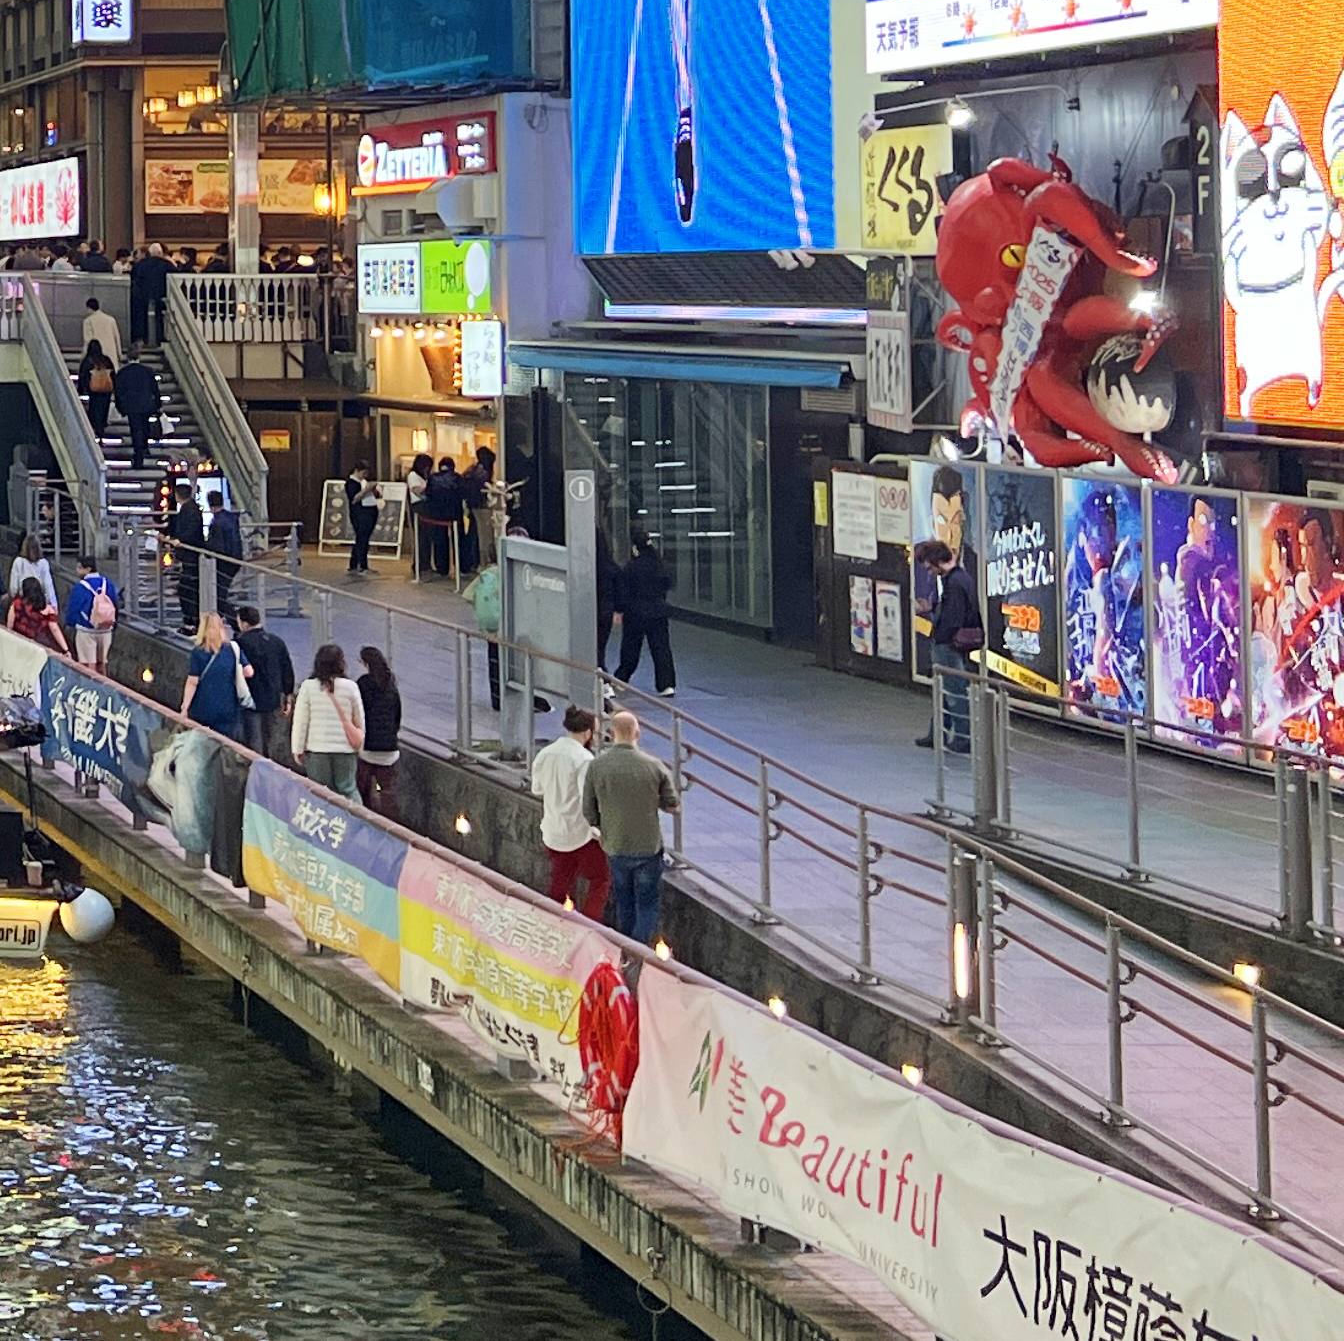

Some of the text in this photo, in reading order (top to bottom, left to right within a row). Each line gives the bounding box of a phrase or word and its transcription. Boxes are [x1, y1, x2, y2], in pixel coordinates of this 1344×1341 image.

[876, 17, 920, 53] 天気予報
[376, 142, 449, 184] ZETTERIA
[758, 1085, 946, 1249] Beautiful
